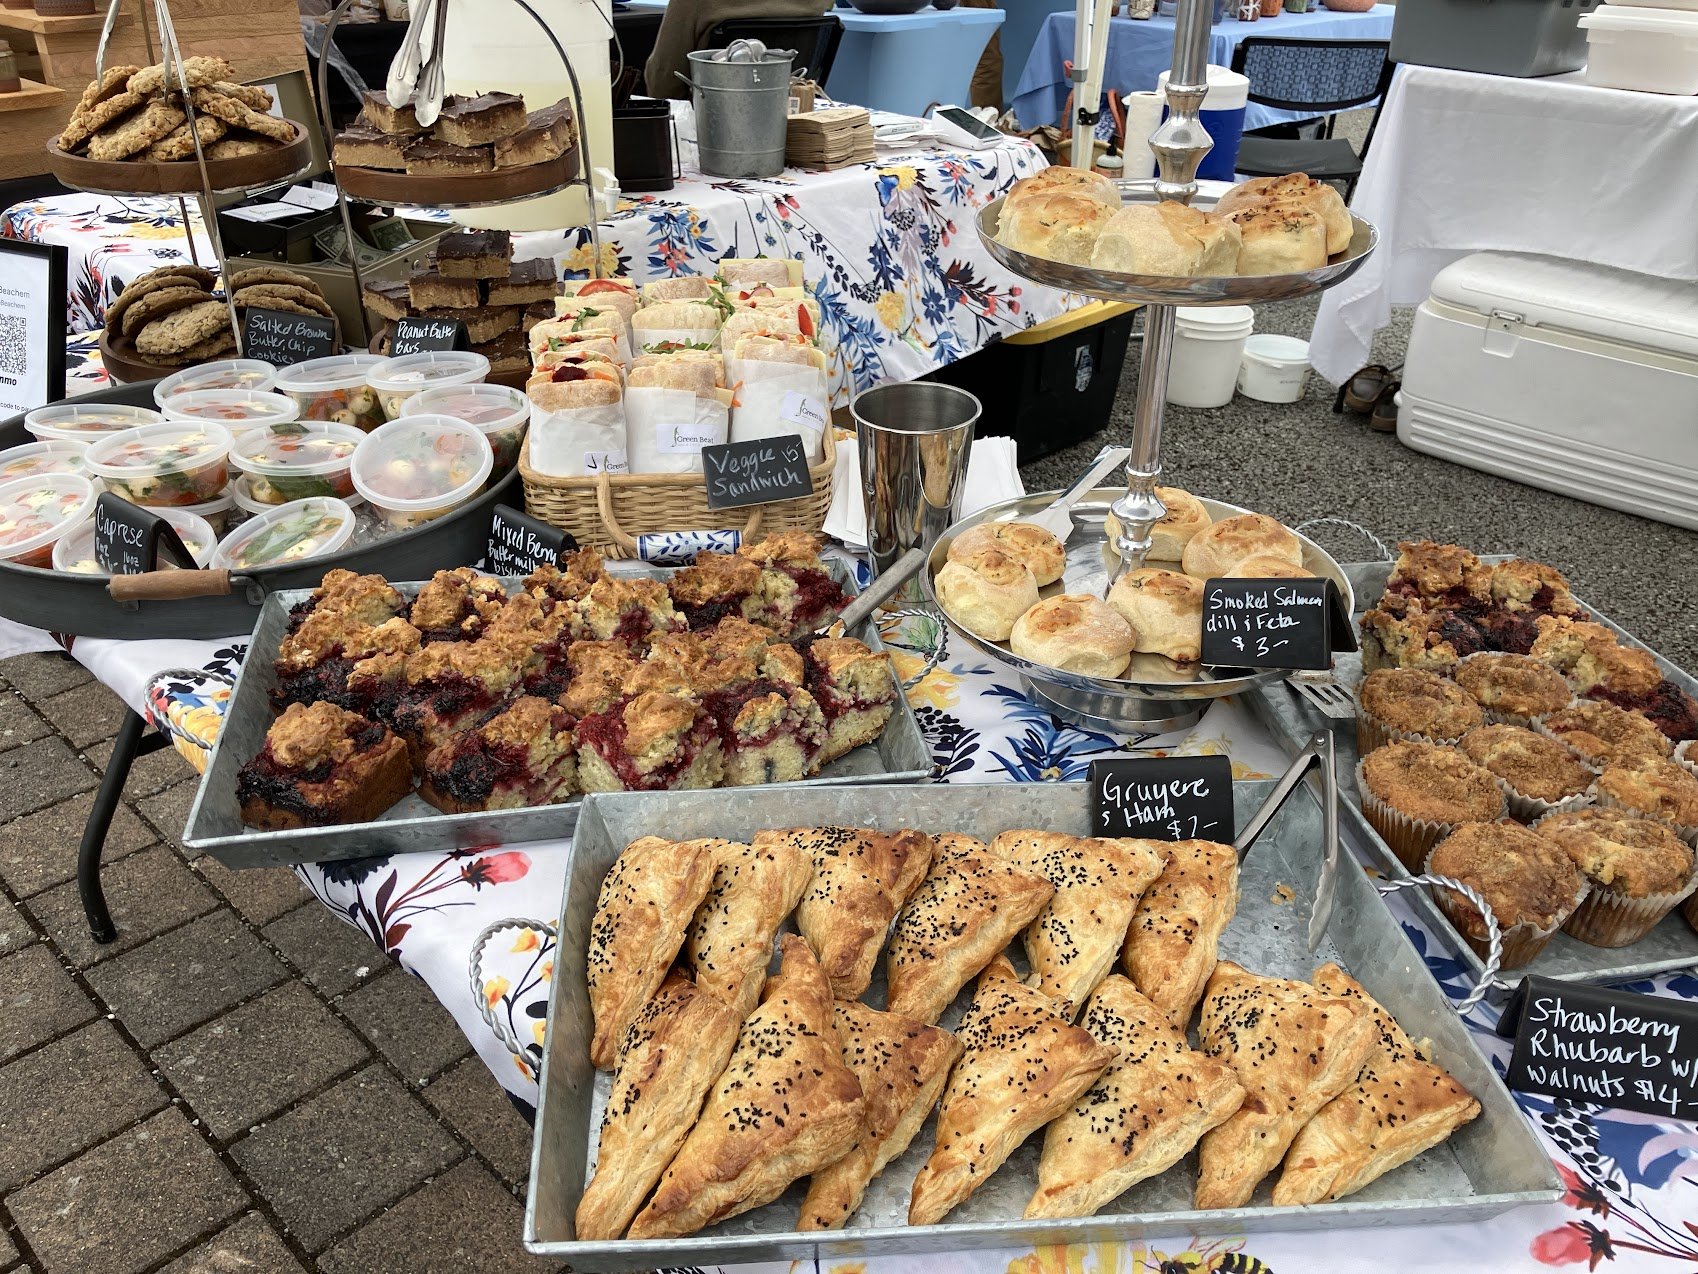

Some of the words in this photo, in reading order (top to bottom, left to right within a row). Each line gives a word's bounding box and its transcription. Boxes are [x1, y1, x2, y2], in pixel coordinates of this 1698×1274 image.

[250, 315, 293, 335] Salted
[295, 322, 332, 341] Brown
[397, 321, 429, 340] Peanut
[429, 322, 456, 339] Butter
[287, 338, 316, 357] Chip
[708, 448, 776, 478] Veggie
[712, 467, 803, 498] Sandwich
[96, 503, 144, 548] Caprese
[492, 514, 525, 551] Mixed
[526, 533, 557, 567] Berry
[1209, 588, 1269, 610] Smoked
[1206, 613, 1237, 632] dill
[1256, 612, 1301, 630] Feta
[1102, 772, 1210, 809] Gruyere
[1123, 801, 1176, 828] Ham
[1529, 997, 1681, 1054] Strawberry
[1530, 1027, 1662, 1068] Rhubarb
